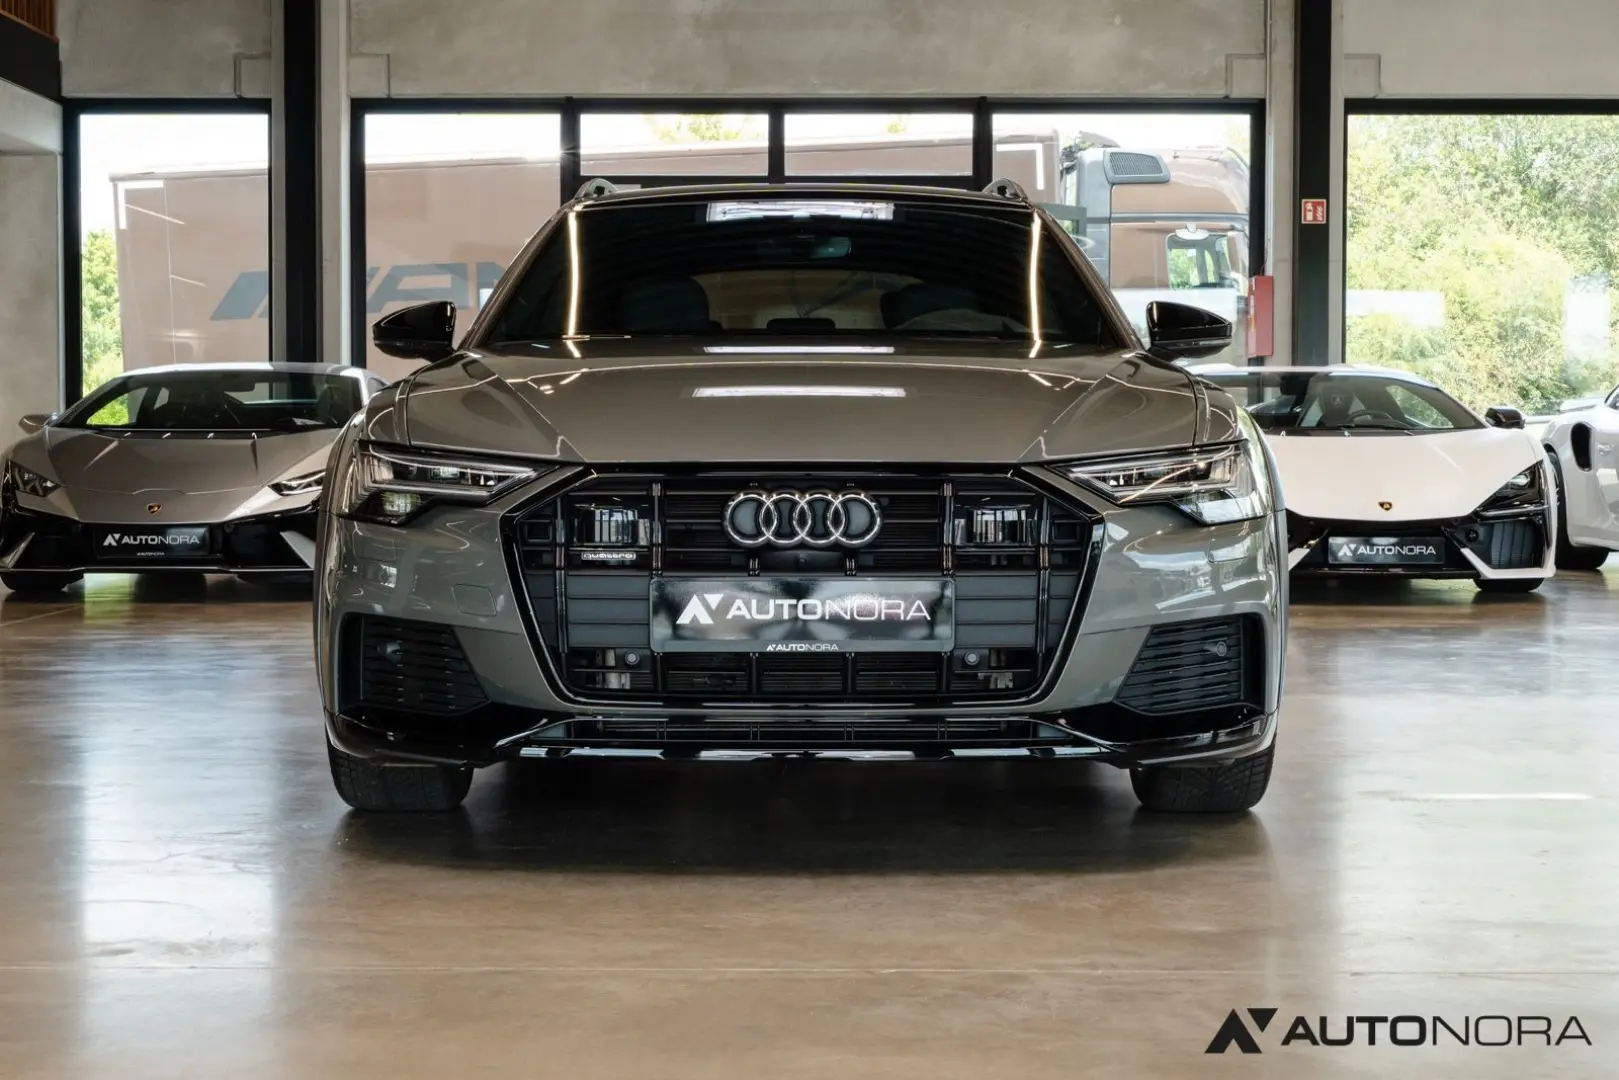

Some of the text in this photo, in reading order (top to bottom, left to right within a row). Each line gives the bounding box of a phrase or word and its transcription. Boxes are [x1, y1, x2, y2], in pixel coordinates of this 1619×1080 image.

[121, 535, 200, 545] AUTONORA
[1356, 545, 1436, 555] AUTONORA
[583, 552, 633, 560] quattro
[725, 599, 931, 621] AUTONORA
[775, 643, 839, 652] AUTONORA
